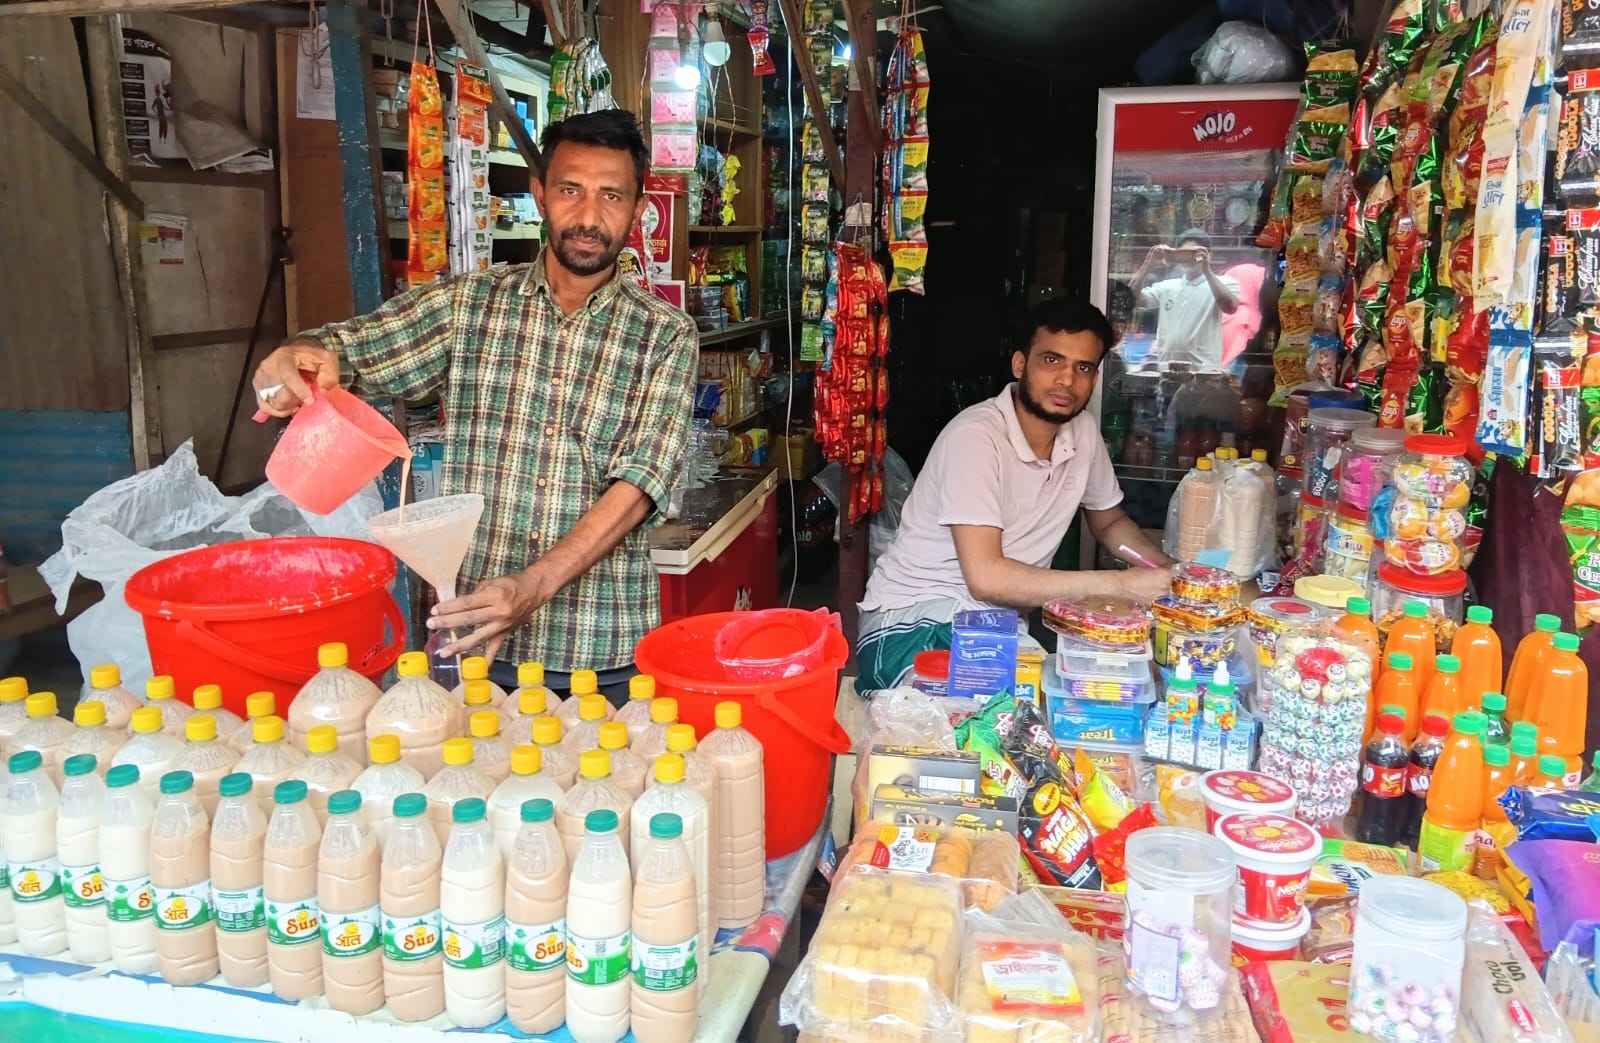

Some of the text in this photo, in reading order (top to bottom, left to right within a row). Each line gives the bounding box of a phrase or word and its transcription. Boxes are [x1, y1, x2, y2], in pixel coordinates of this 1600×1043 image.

[1192, 112, 1236, 142] MOJO
[1080, 728, 1116, 741] Treat
[81, 881, 103, 898] Su
[138, 892, 151, 909] S
[286, 916, 318, 936] Sun
[403, 933, 435, 951] Sun
[534, 941, 564, 960] Sun
[1484, 960, 1514, 995] Choco
